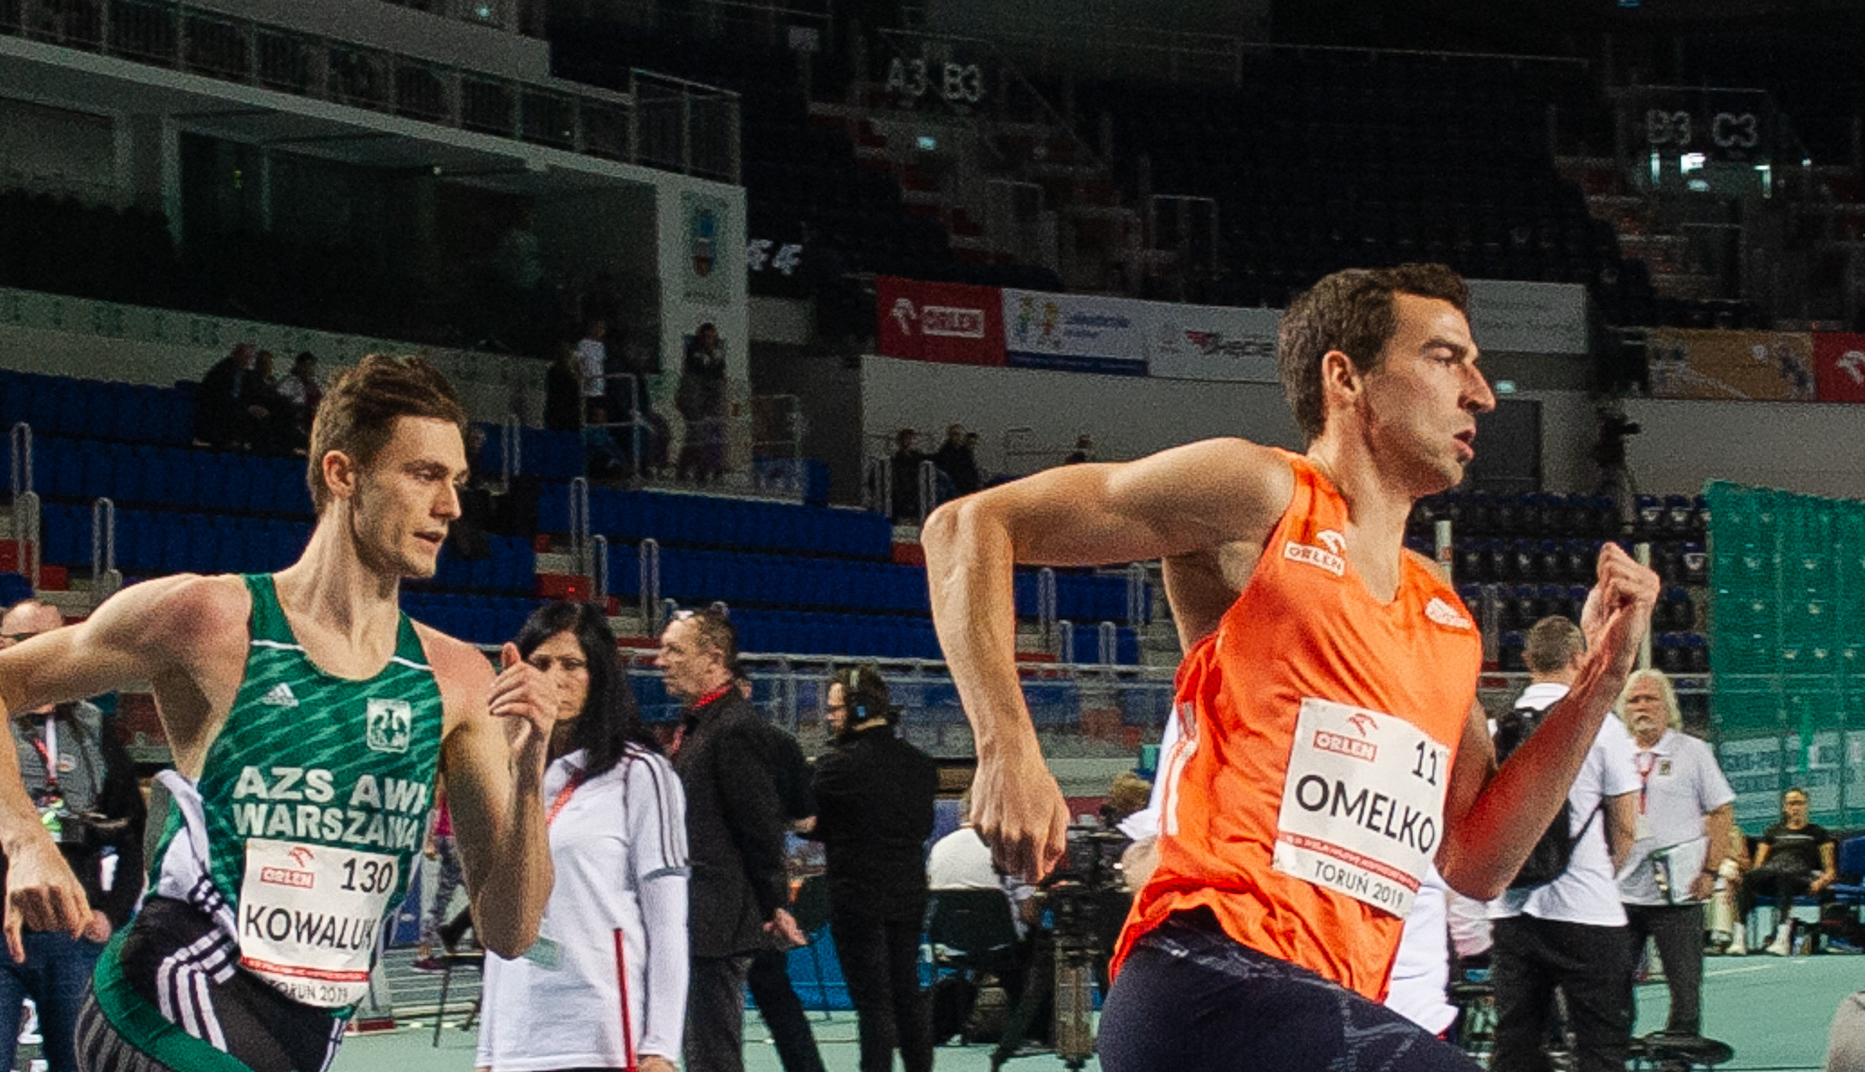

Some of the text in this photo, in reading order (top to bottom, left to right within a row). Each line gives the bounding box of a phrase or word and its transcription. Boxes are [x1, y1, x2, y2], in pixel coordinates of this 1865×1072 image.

[943, 63, 982, 102] B3
[1713, 112, 1758, 148] C3
[1286, 543, 1344, 575] ORLEN
[1315, 732, 1377, 762] ORLEN
[1411, 740, 1438, 787] 11
[232, 765, 334, 803] AZS
[232, 803, 420, 852] WARSZAWA
[1295, 774, 1437, 854] OMELKO
[340, 857, 394, 894] 130
[1314, 860, 1371, 896] TORUŃ
